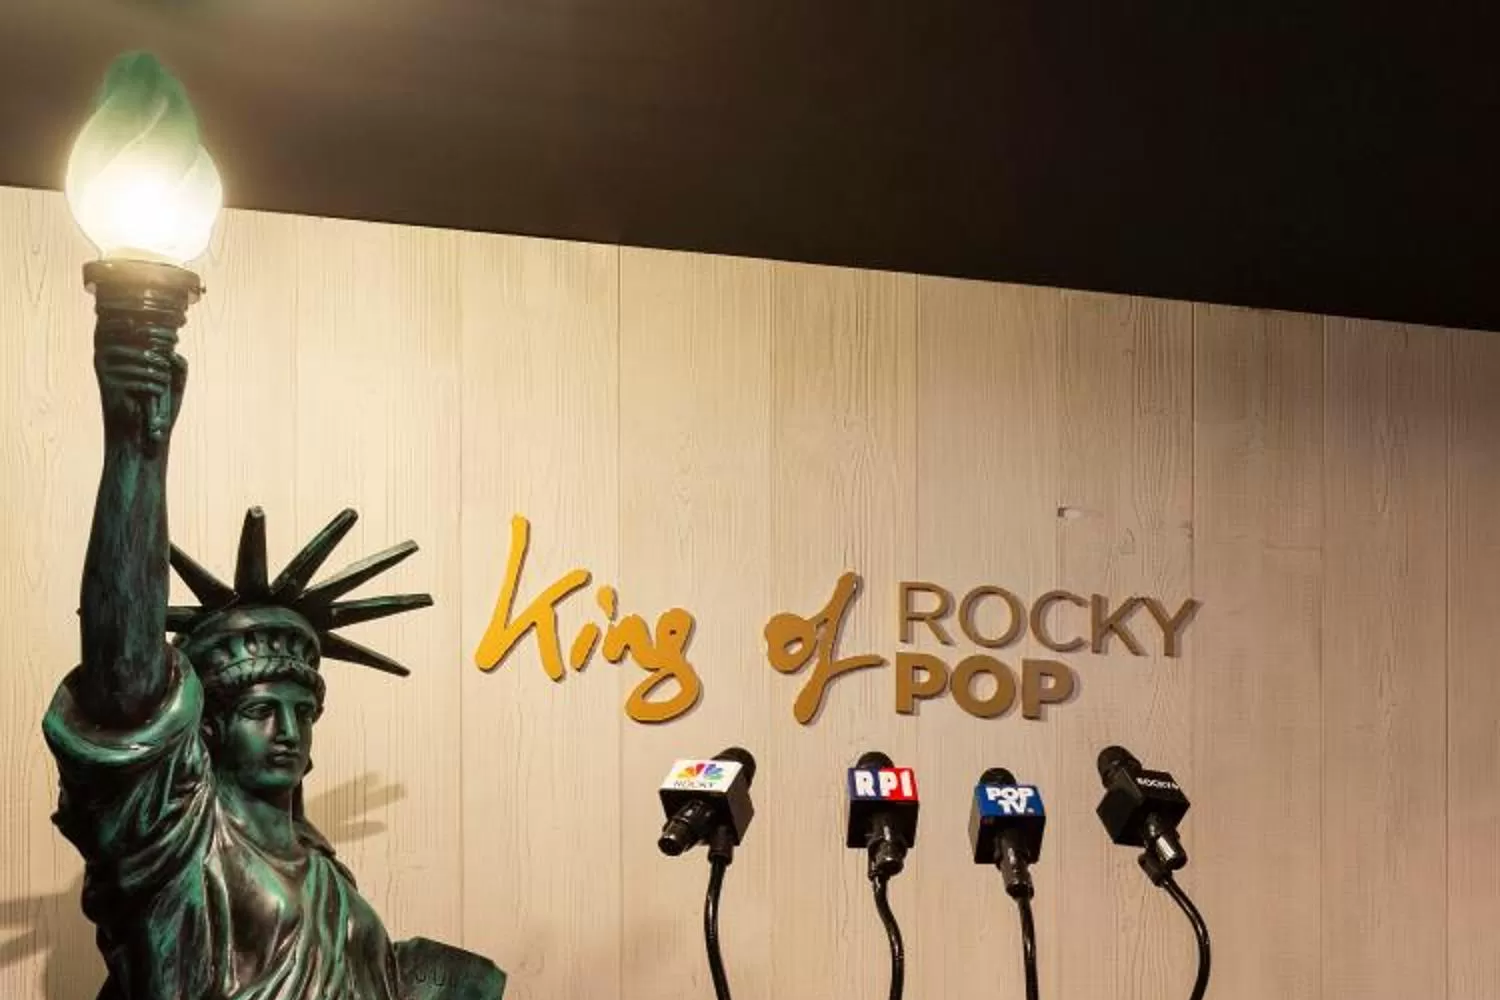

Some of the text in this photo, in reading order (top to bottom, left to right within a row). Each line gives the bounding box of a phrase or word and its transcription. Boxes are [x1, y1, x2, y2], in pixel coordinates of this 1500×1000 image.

[475, 513, 1199, 725] King of ROCKY
[896, 652, 1077, 720] POP
[985, 787, 1034, 801] POP
